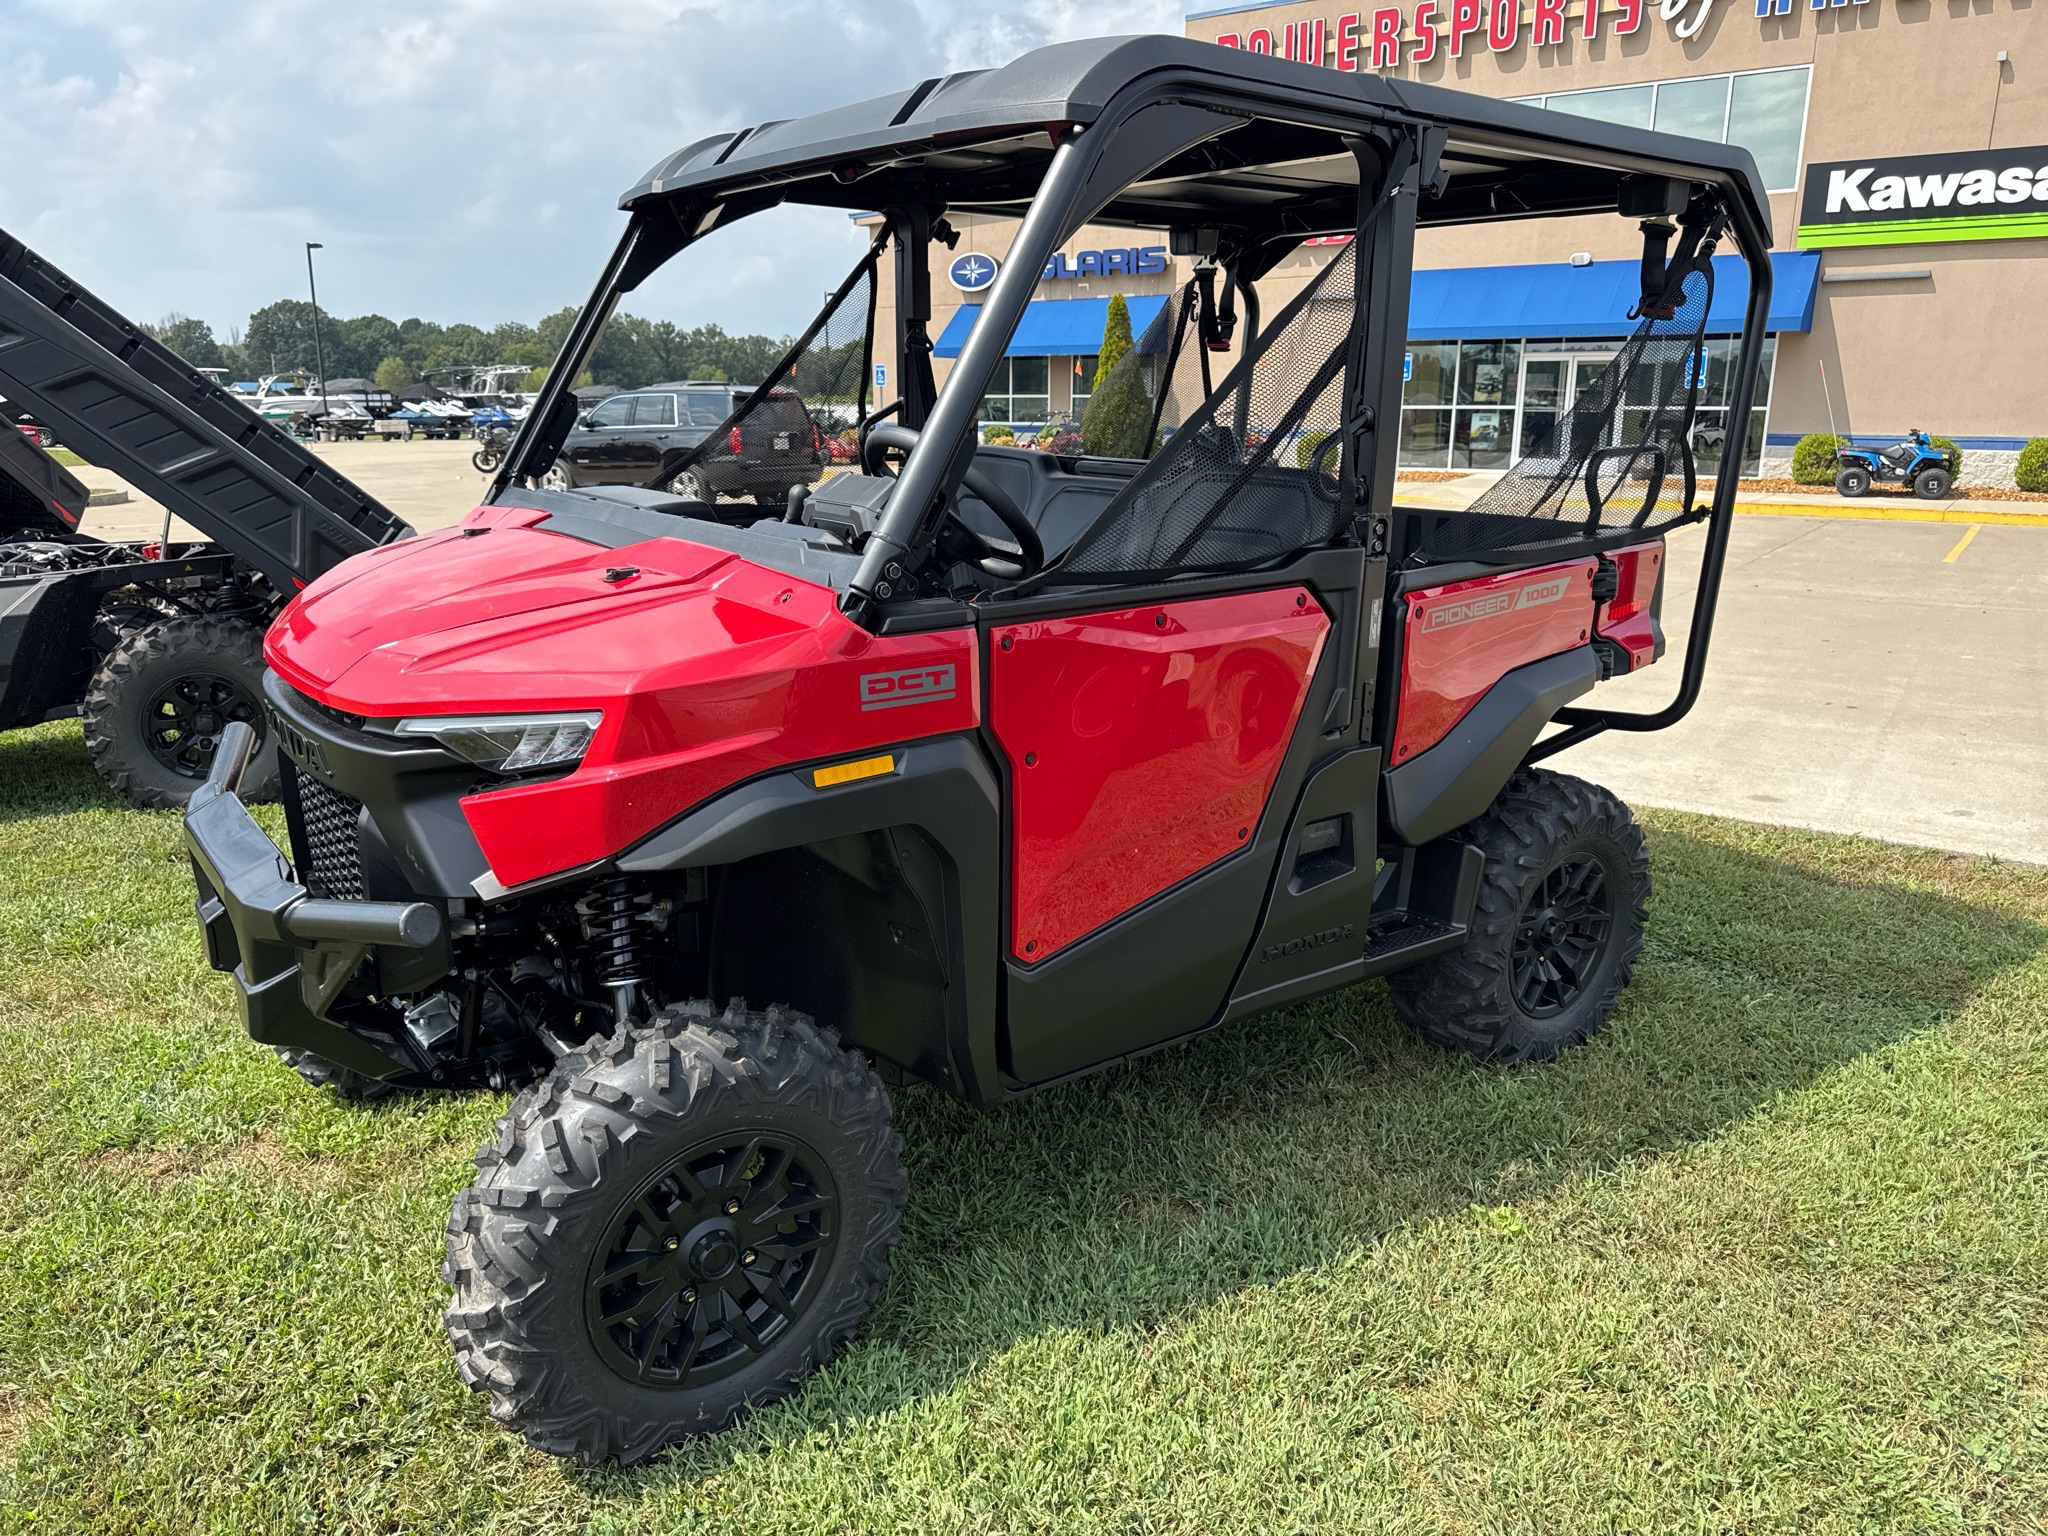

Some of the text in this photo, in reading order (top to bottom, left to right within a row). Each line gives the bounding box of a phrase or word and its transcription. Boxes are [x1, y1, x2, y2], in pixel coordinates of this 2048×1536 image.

[1431, 584, 1560, 627] PIONEER 1000
[867, 669, 950, 695] DCT
[1261, 923, 1358, 963] HONDA
